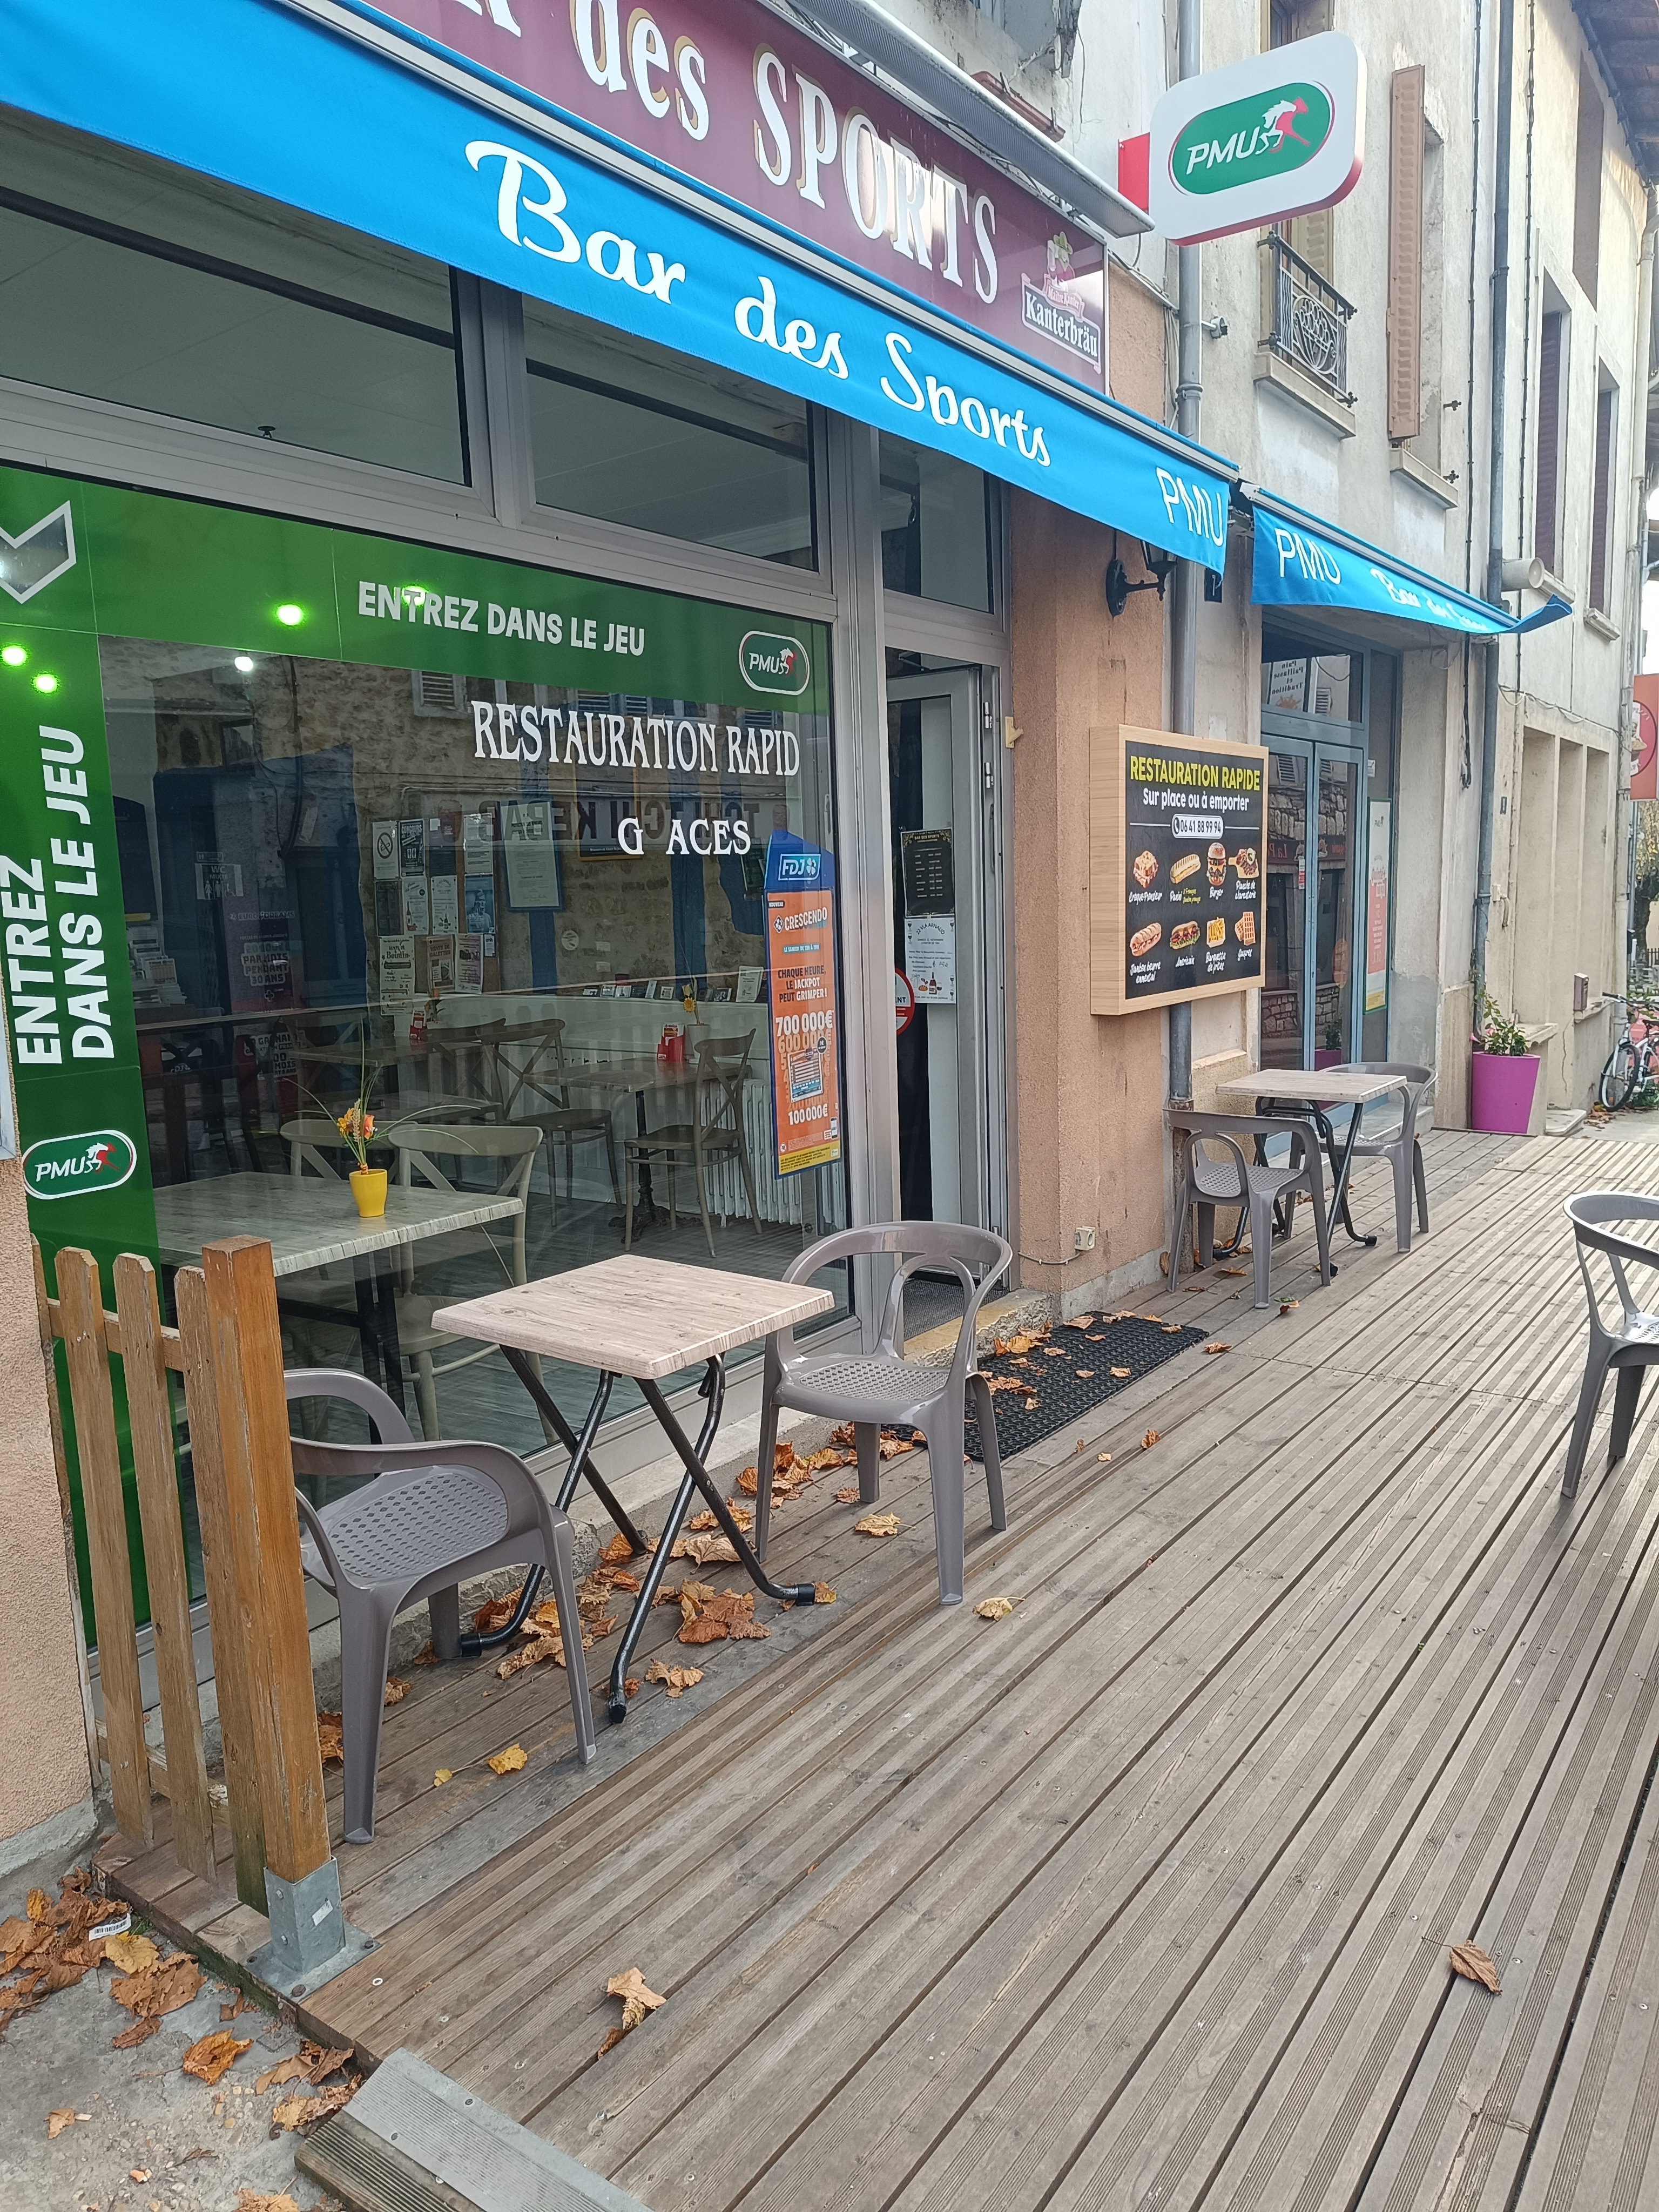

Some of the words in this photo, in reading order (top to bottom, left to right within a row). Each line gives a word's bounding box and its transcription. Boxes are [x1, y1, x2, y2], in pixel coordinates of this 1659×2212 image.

[1186, 127, 1260, 176] PMU
[755, 51, 998, 304] SPORTS
[1026, 291, 1098, 357] Kanterbräu
[465, 140, 685, 304] Bar
[734, 276, 848, 379] des
[880, 333, 1051, 467] Sports
[1156, 467, 1224, 547] PMU
[1274, 528, 1341, 585] PMU
[358, 581, 478, 632] ENTREZ
[488, 604, 562, 645] DANS
[570, 618, 597, 650] LE
[603, 622, 645, 657] JEU
[749, 652, 782, 675] PMU
[471, 700, 719, 773] RESTAURATION
[727, 726, 800, 776] RAPID
[39, 725, 91, 825] JEU
[1130, 756, 1219, 788] RESTAURATION
[1222, 766, 1260, 791] RAPIDE
[1143, 787, 1159, 806] Sur
[1161, 788, 1186, 810] place
[1188, 795, 1199, 809] ou
[1202, 791, 1208, 809] à
[1209, 794, 1249, 813] emporter
[1180, 819, 1188, 832] 06
[1189, 819, 1196, 833] 41
[1197, 820, 1205, 833] 88
[1206, 820, 1213, 833] 99
[1214, 820, 1221, 833] 94
[51, 838, 98, 897] LE
[211, 865, 226, 873] WC
[782, 859, 805, 875] FDJ
[1209, 886, 1224, 900] Burger
[785, 907, 828, 931] CRESCENDO
[928, 922, 945, 935] ARNAUD
[0, 854, 63, 1064] ENTREZ
[246, 964, 287, 974] PENDANT
[265, 974, 284, 983] ANS
[778, 967, 803, 979] CHAQUE
[804, 965, 826, 976] HEURE,
[786, 980, 793, 990] LE
[794, 977, 820, 990] JACKPOT
[59, 913, 114, 1058] DANS
[779, 992, 795, 1003] PEUT
[775, 1014, 800, 1037] 700
[778, 1033, 800, 1054] 600
[274, 1061, 296, 1070] MOIS
[788, 1109, 805, 1125] 100
[806, 1103, 828, 1122] 000€
[35, 1159, 86, 1183] PMU
